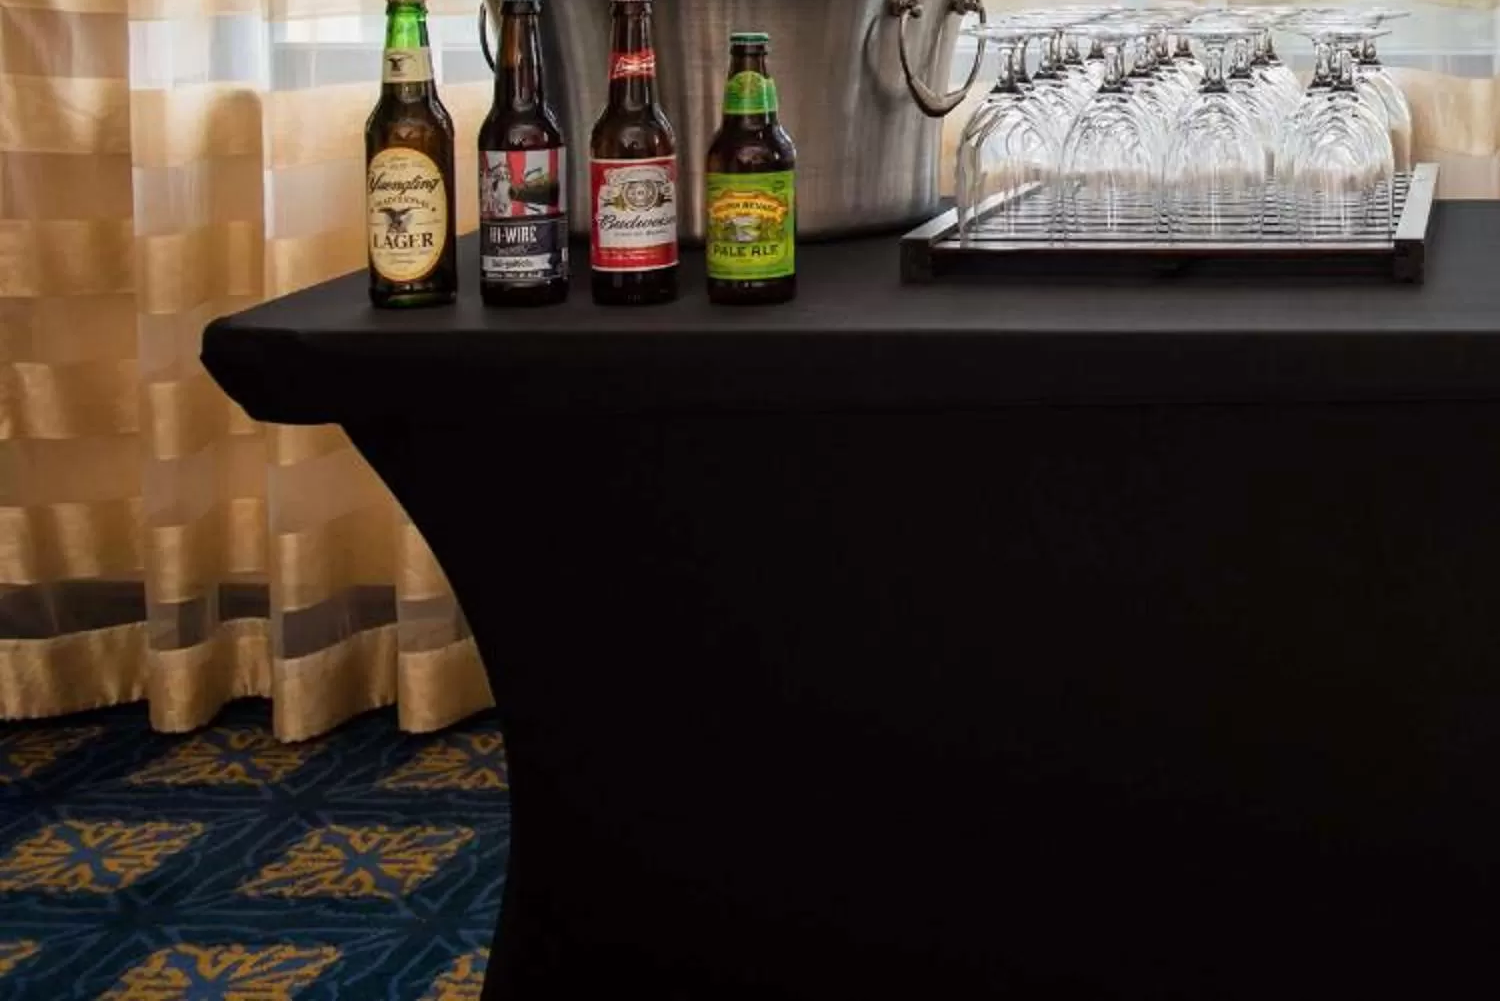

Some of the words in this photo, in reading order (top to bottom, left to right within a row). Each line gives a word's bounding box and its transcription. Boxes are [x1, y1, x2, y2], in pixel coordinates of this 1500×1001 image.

[368, 172, 440, 195] Yuengling
[373, 233, 434, 249] LAGER
[489, 226, 537, 244] HI-WIRE
[714, 245, 746, 257] PALE
[752, 245, 779, 256] ALE
